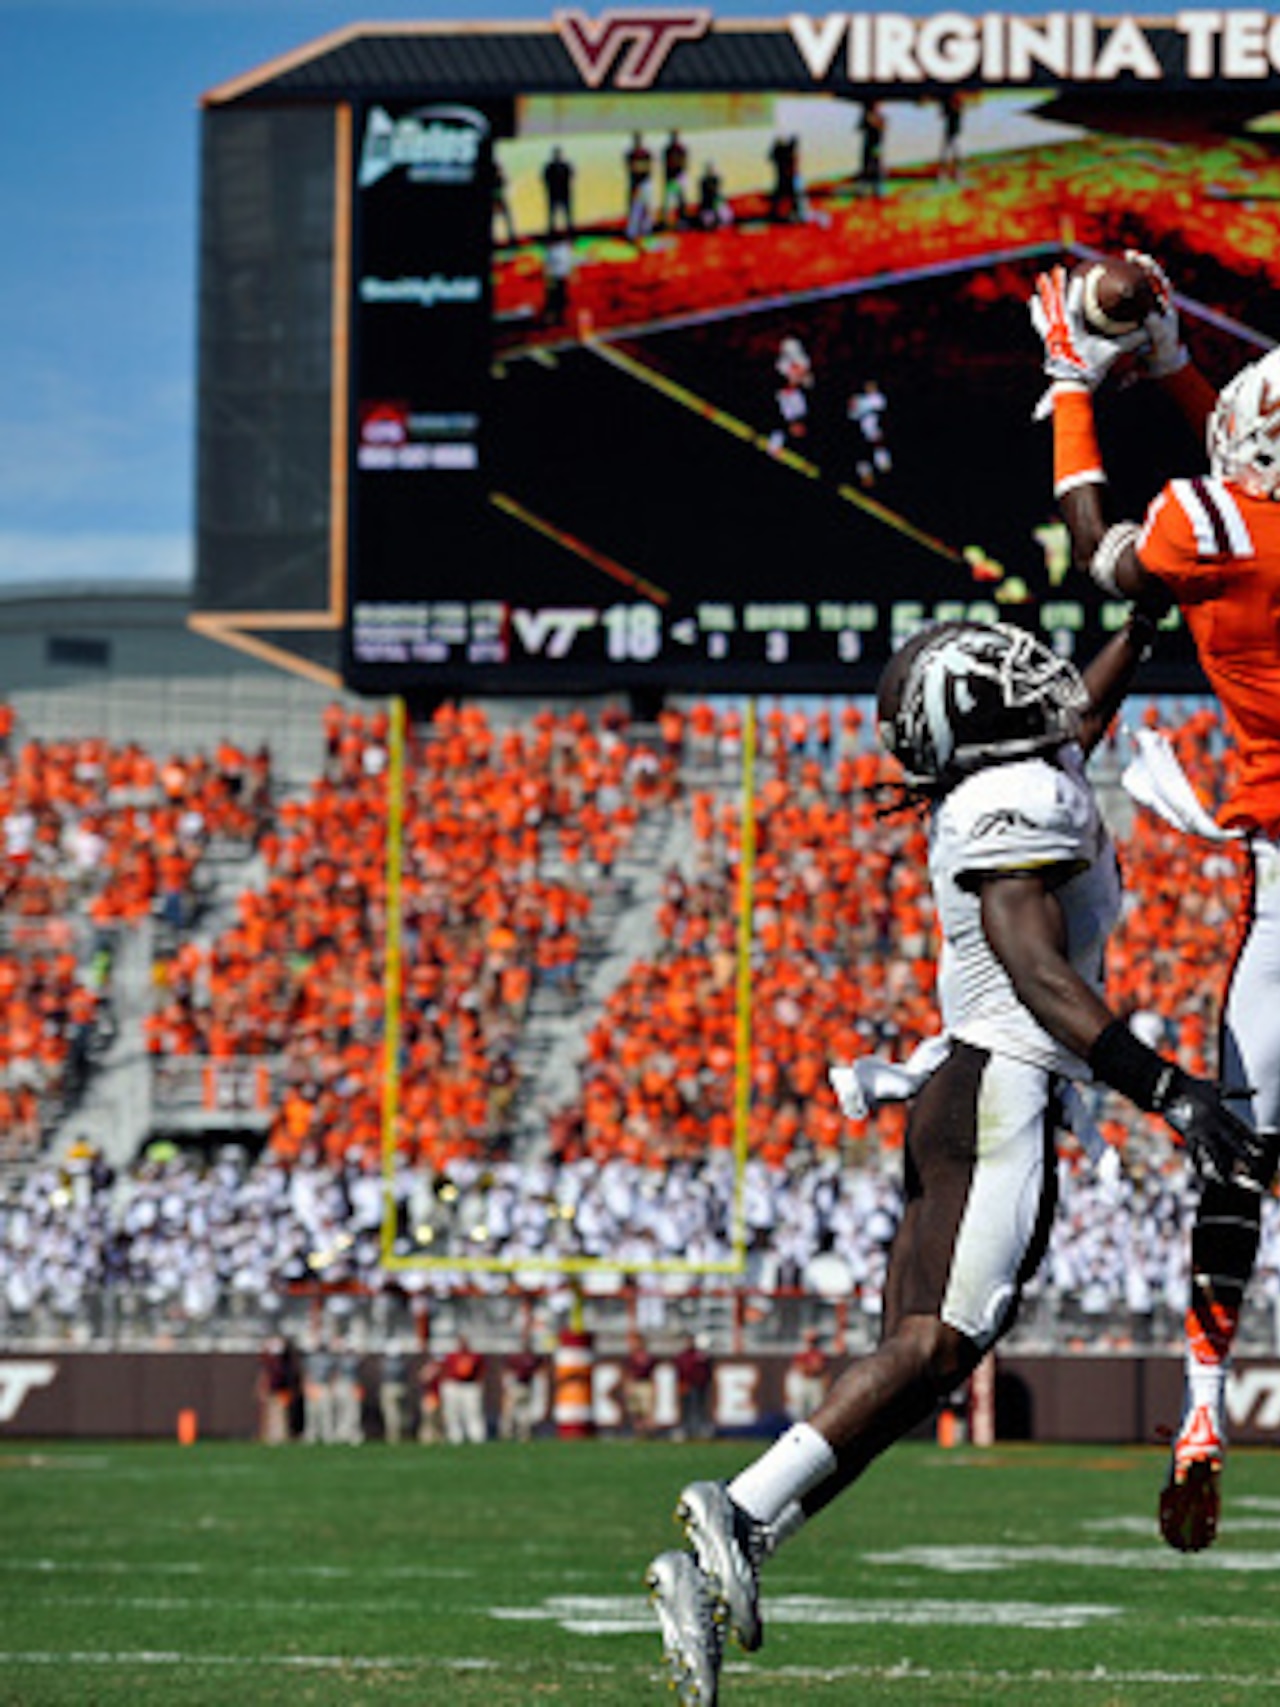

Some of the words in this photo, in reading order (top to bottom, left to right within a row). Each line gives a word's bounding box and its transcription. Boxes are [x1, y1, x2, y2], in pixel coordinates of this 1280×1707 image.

[554, 11, 709, 88] VT
[788, 12, 1162, 82] VIRGINIA
[511, 608, 597, 658] VT
[0, 1361, 58, 1421] T
